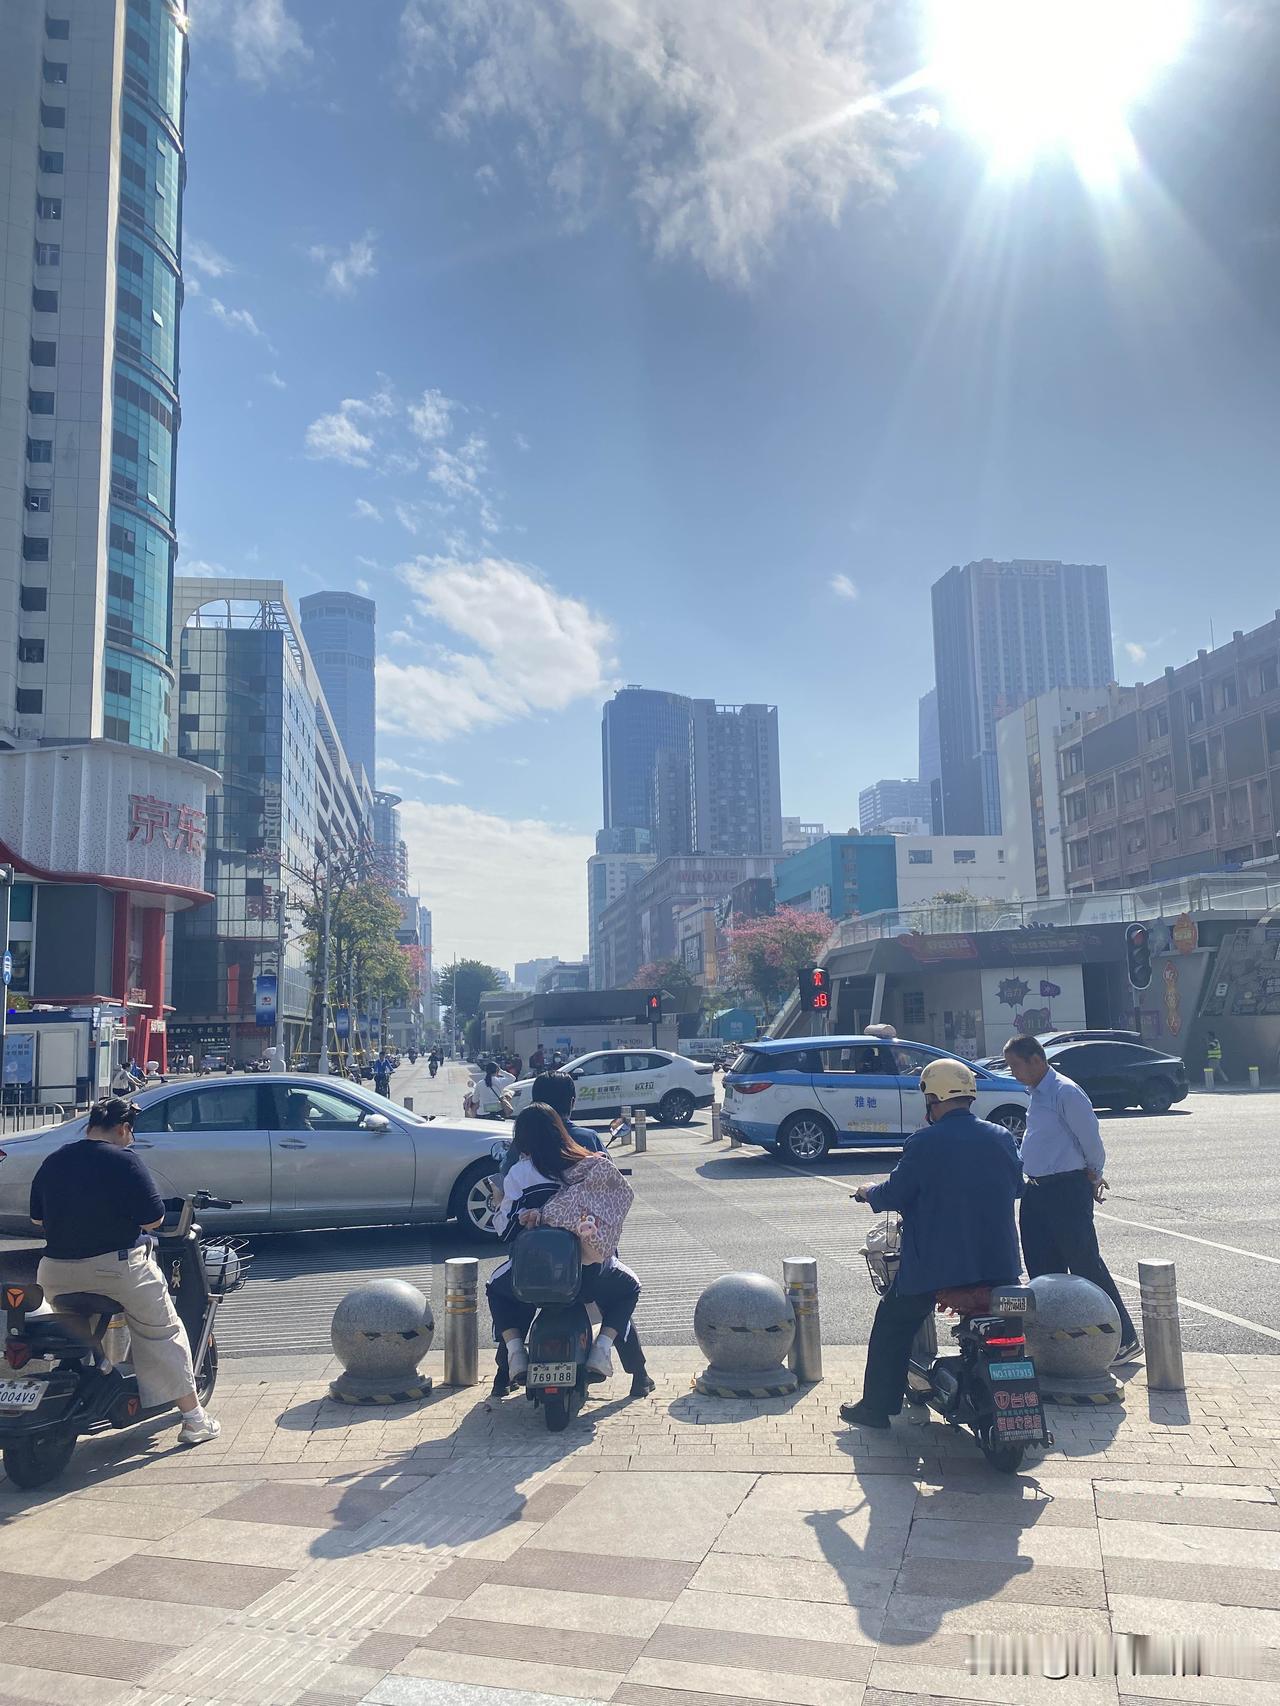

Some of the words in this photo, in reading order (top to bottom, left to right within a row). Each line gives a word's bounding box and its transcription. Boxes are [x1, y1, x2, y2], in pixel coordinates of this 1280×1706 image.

[128, 794, 206, 856] 京东
[634, 1081, 655, 1091] 欧拉
[579, 1086, 597, 1101] 24
[854, 1095, 877, 1108] 雅驰
[533, 1372, 571, 1383] 769188
[0, 1391, 36, 1403] 004V9
